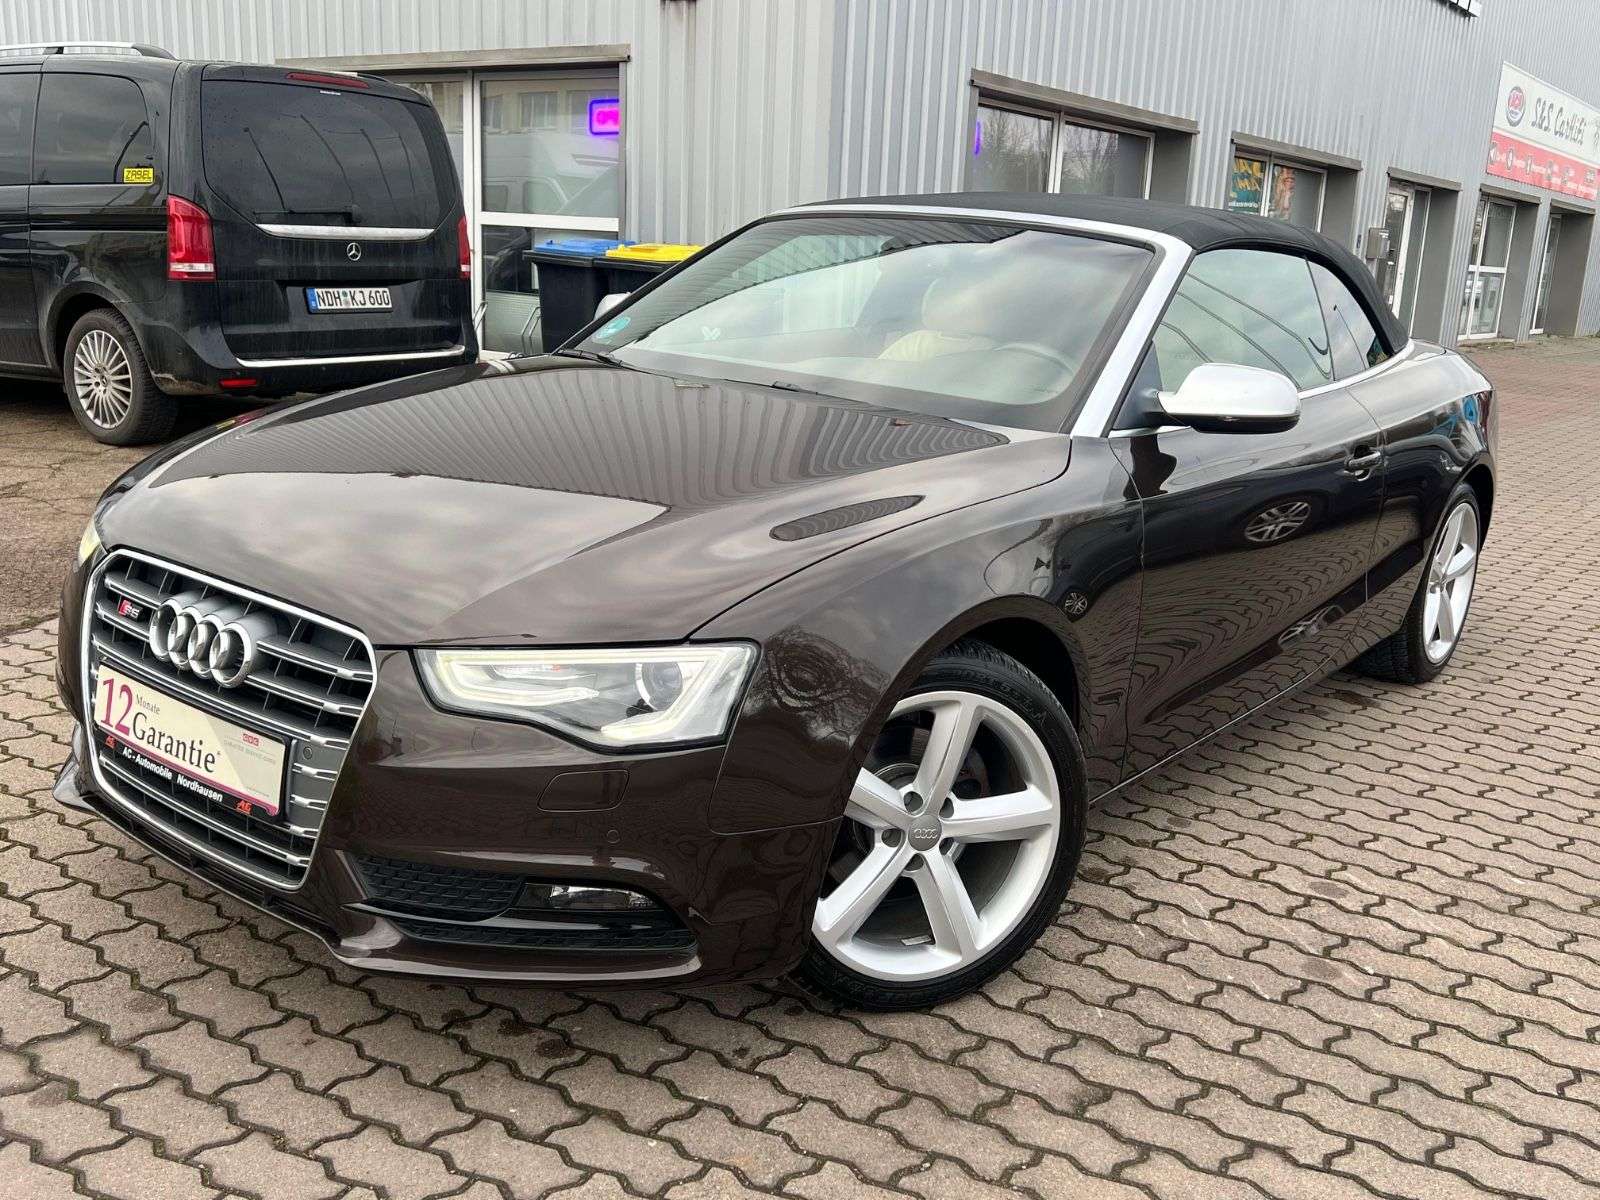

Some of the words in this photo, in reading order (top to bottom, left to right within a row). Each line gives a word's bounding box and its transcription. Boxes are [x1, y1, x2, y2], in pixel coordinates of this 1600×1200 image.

[316, 290, 343, 307] NDH
[349, 290, 367, 306] KJ
[368, 290, 390, 306] 600
[101, 678, 133, 736] 12
[136, 693, 160, 715] Monate
[176, 774, 223, 803] Nordhausen
